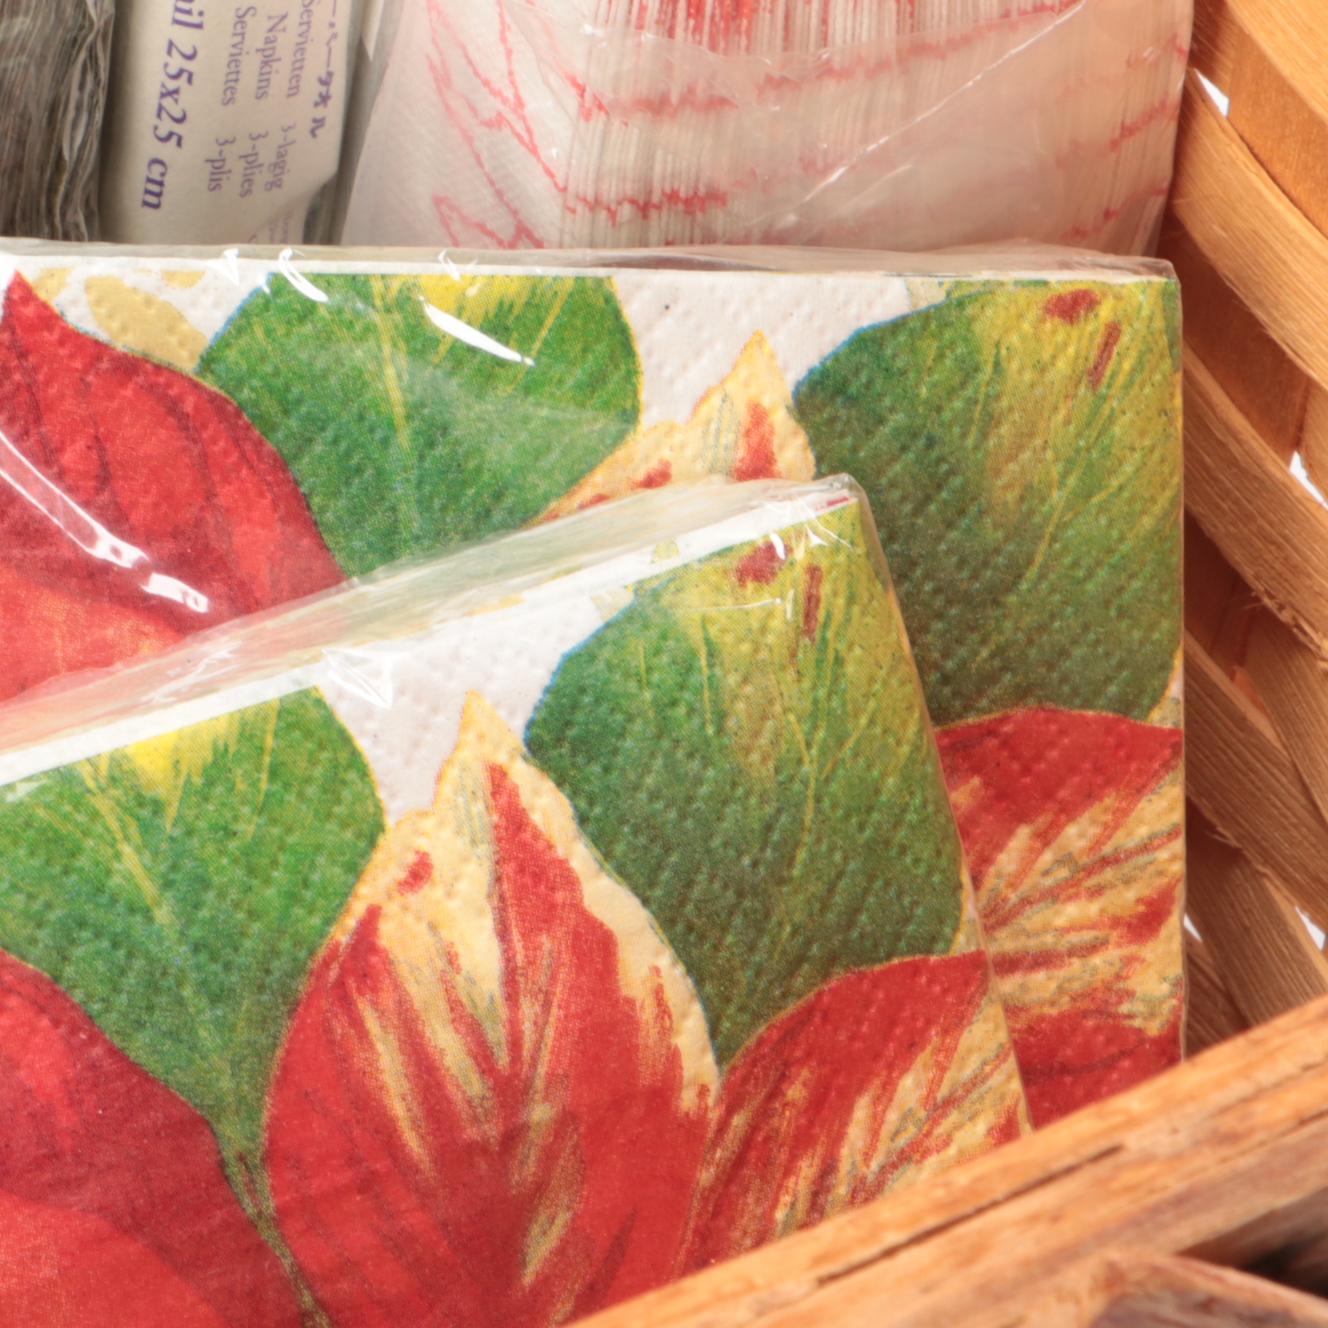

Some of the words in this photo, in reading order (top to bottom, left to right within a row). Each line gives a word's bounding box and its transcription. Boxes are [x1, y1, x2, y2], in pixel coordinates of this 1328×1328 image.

[221, 6, 257, 107] Serviettes
[254, 13, 289, 102] Napkins
[153, 38, 199, 150] 25x25
[141, 157, 169, 211] cm
[203, 135, 237, 193] 3-plis
[238, 130, 270, 199] 3-plies
[264, 122, 298, 193] 3-lagig
